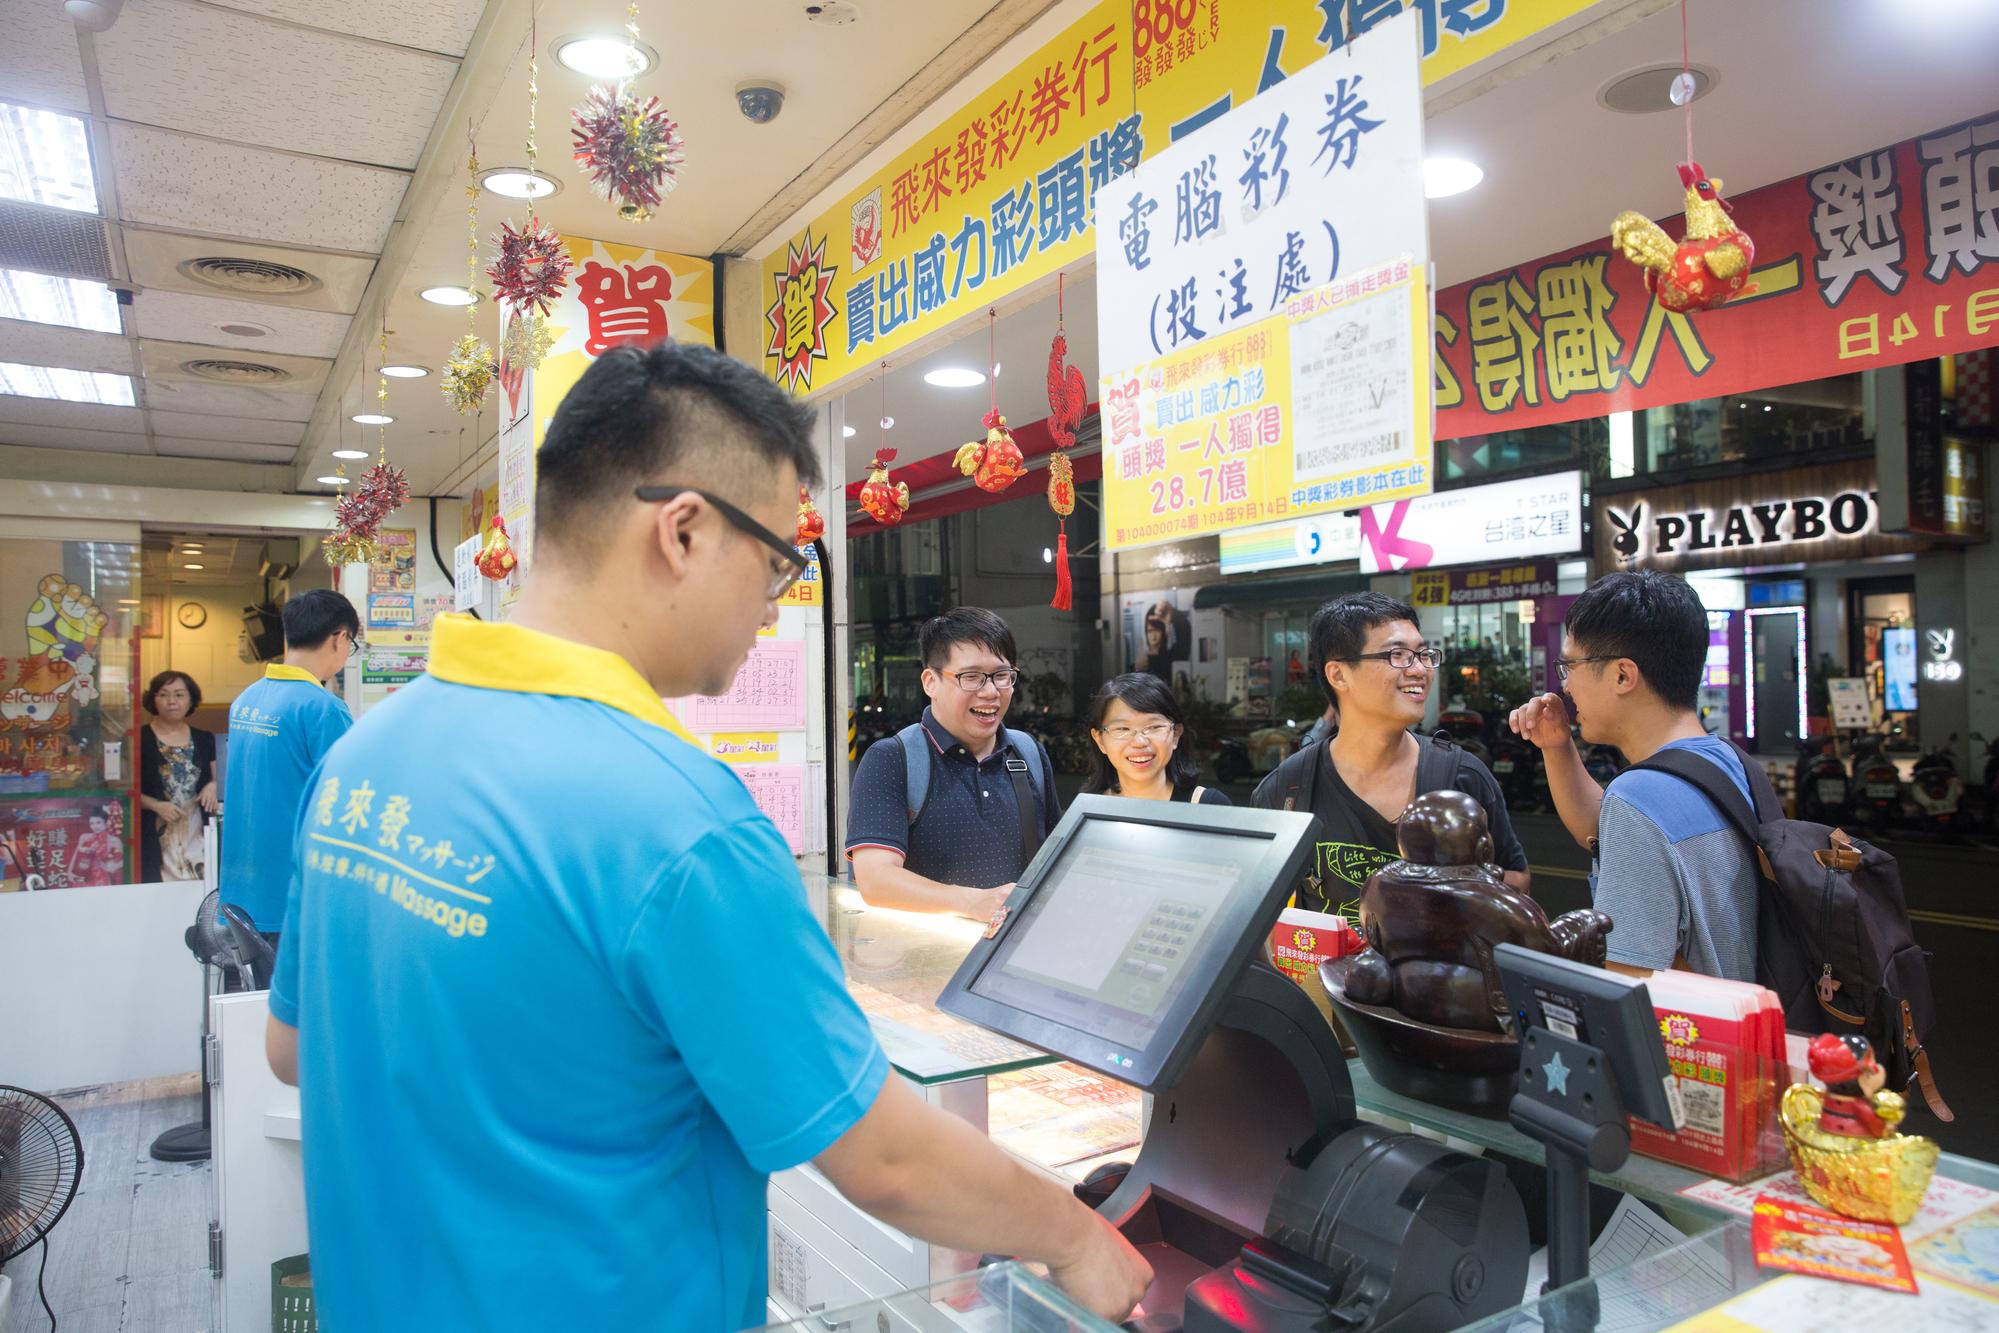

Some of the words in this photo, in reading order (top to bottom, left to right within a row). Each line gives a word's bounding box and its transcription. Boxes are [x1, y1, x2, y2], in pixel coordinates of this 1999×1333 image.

[1117, 73, 1388, 272] 電腦彩券
[575, 260, 673, 360] 賀
[783, 261, 819, 361] 賀
[1151, 459, 1248, 515] 28.7億
[1655, 491, 1880, 553] PLAYBO
[0, 690, 67, 705] elcome
